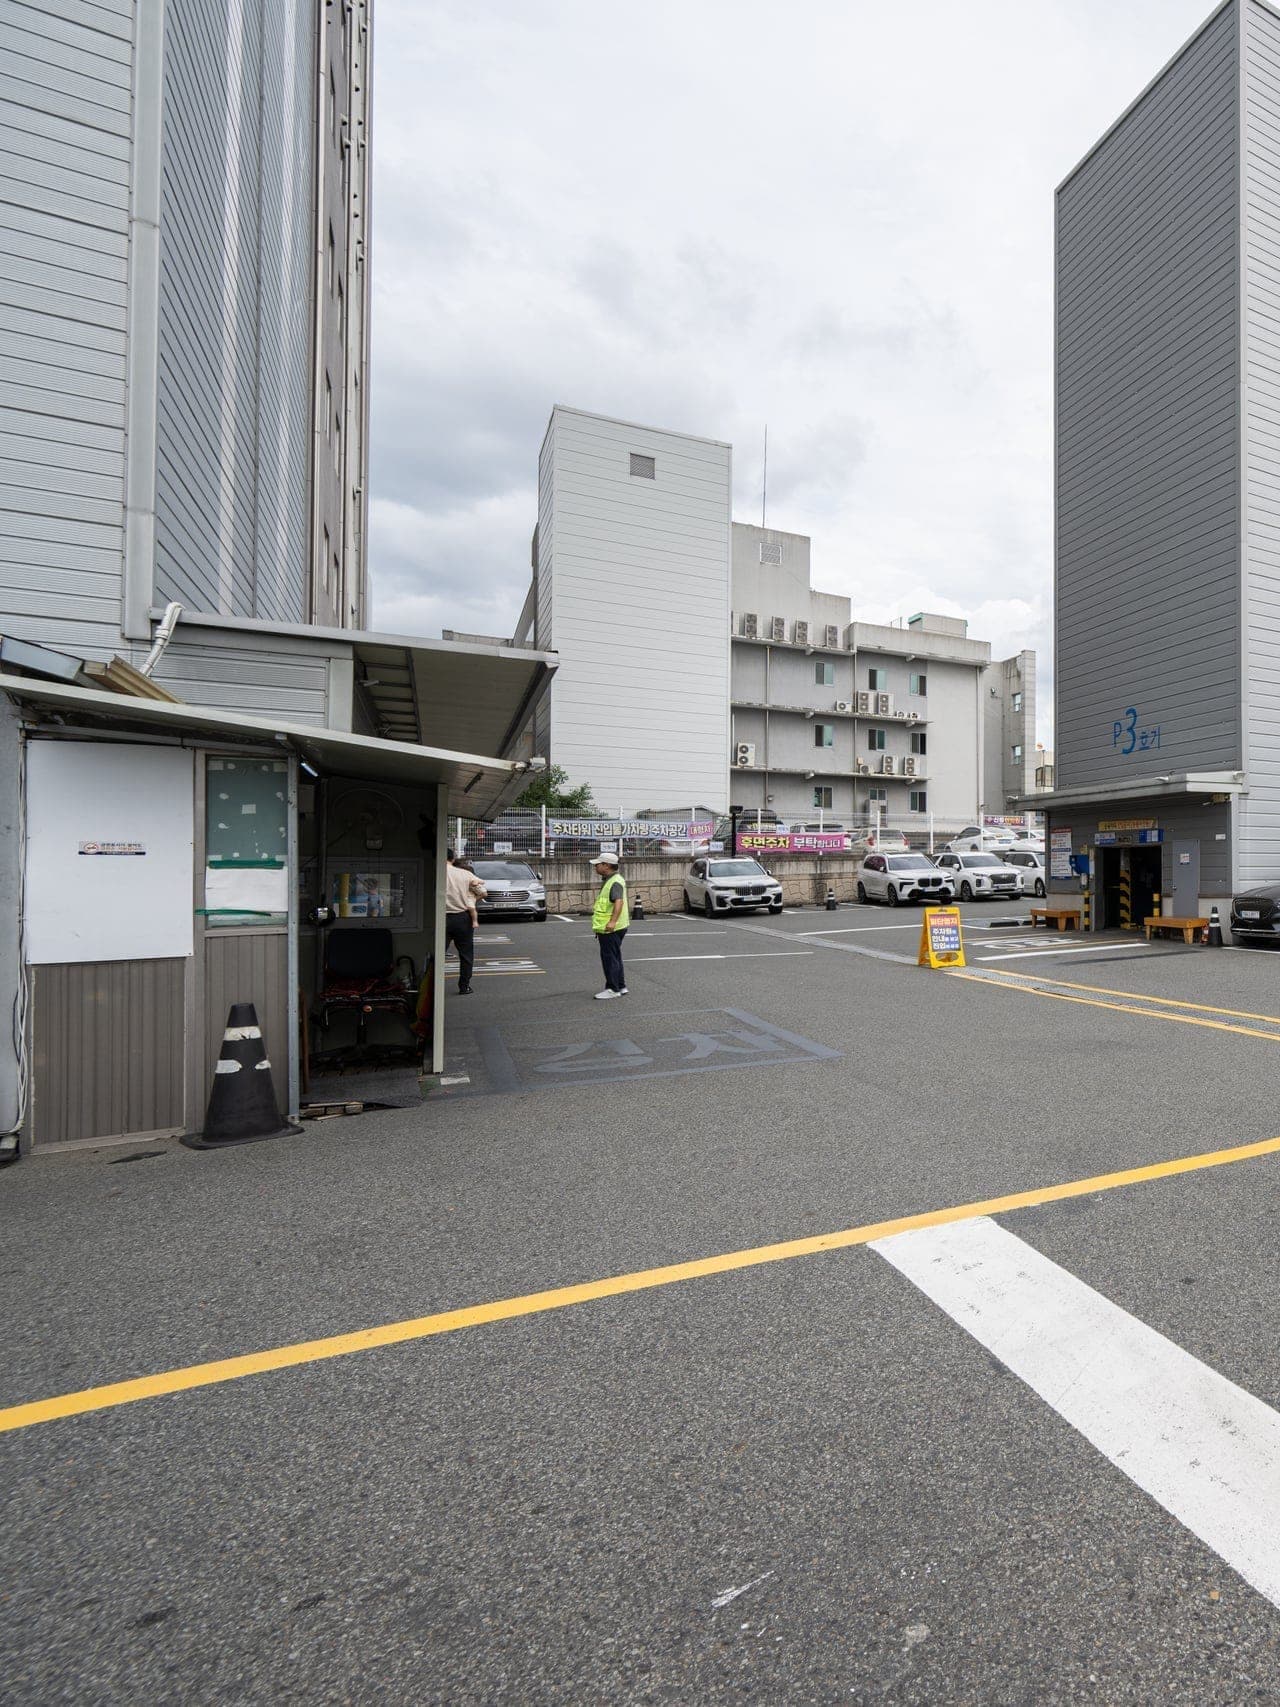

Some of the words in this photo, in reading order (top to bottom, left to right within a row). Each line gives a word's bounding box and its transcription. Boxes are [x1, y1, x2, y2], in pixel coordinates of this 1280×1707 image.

[552, 822, 592, 836] 주차타워
[594, 822, 649, 837] 진입불가차량
[651, 822, 687, 838] 주차공간
[740, 836, 790, 849] 후면주차
[793, 836, 841, 849] 부탁합니다
